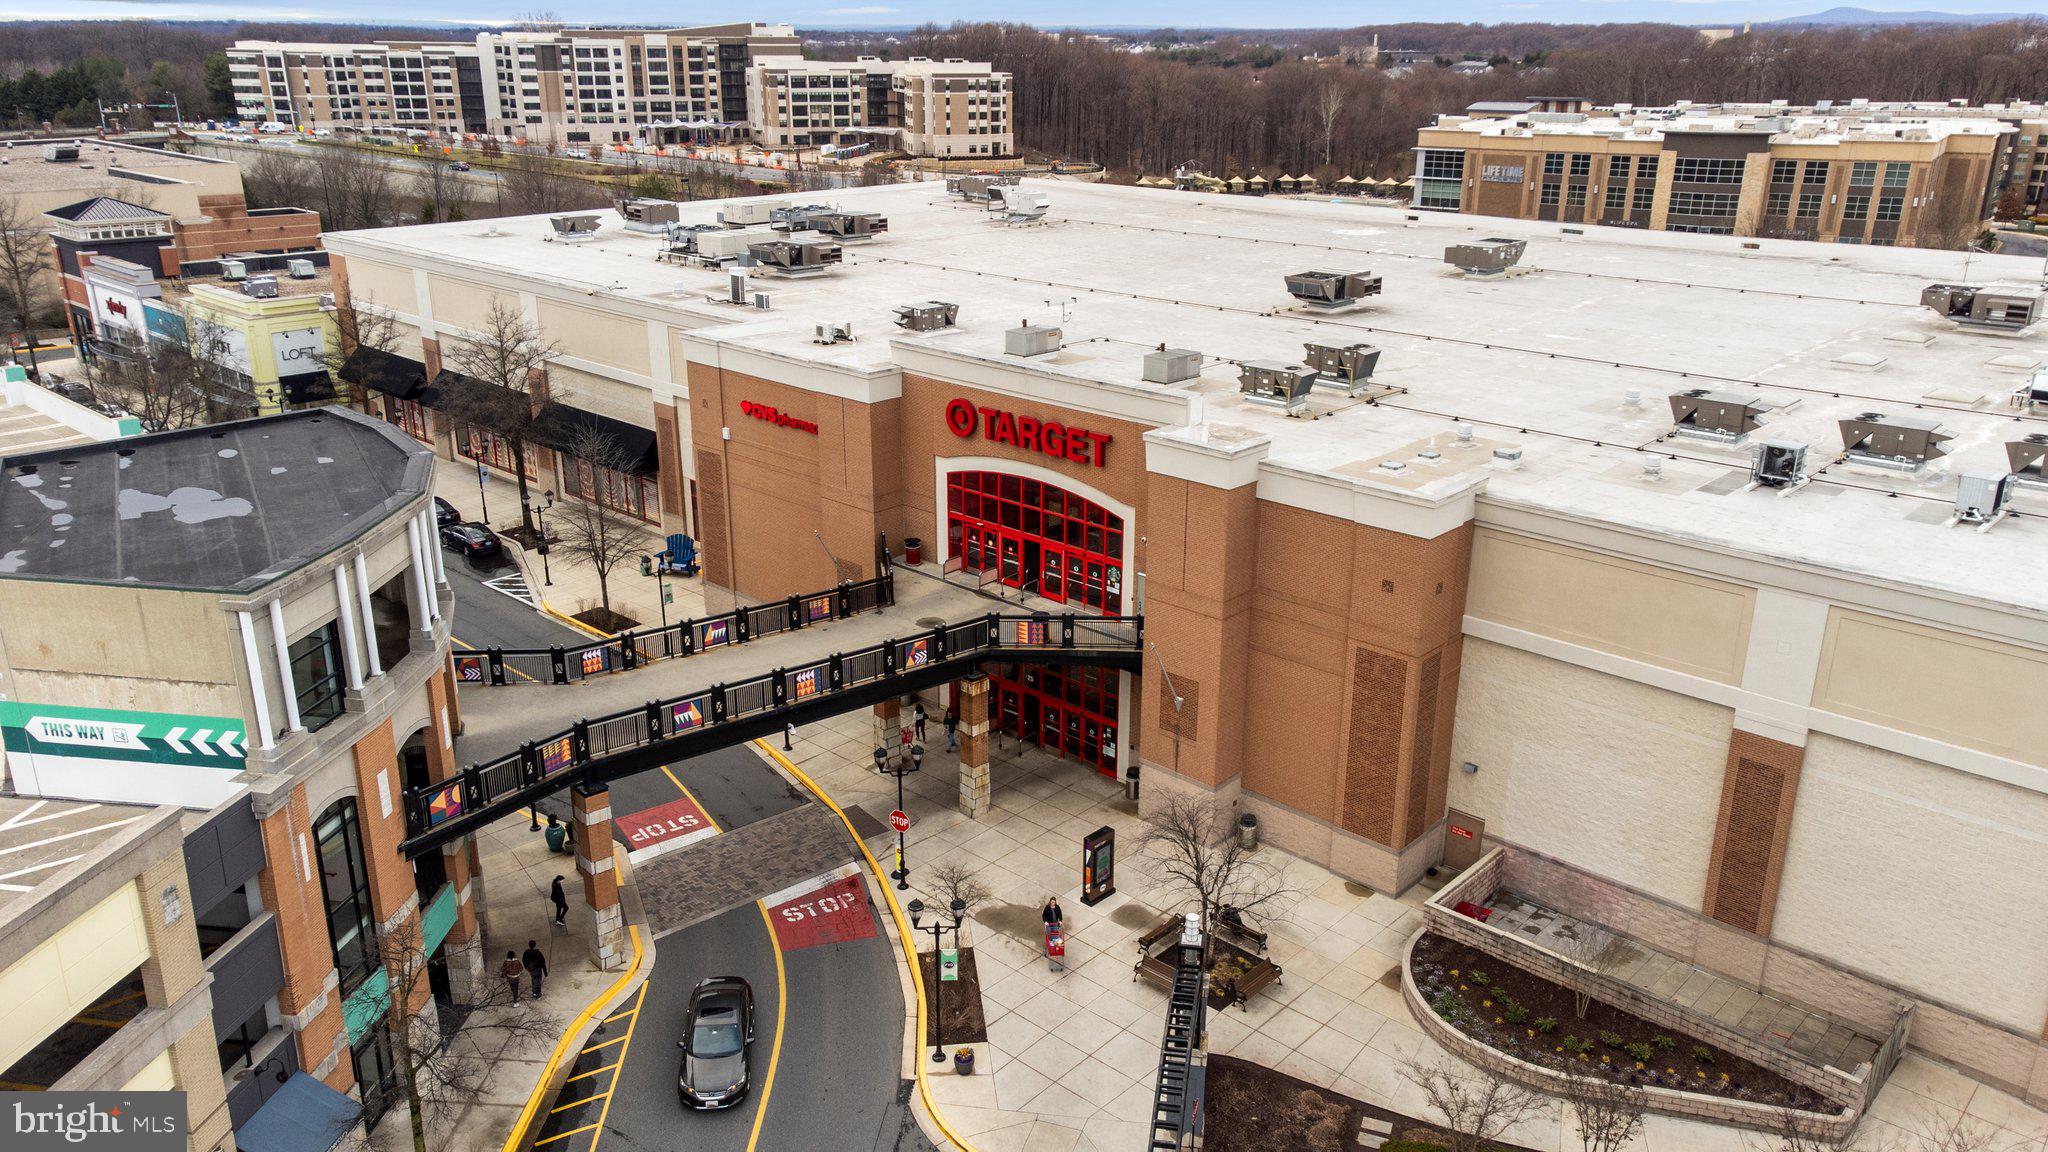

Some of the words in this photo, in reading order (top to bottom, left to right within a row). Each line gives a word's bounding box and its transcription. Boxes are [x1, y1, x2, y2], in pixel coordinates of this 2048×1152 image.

[1482, 164, 1501, 177] LIFE
[1502, 166, 1524, 179] TIME
[281, 345, 316, 361] LOFT
[751, 403, 778, 424] CVS
[777, 413, 819, 436] pharmac
[978, 406, 1114, 468] TARGET
[41, 722, 73, 738] THIS
[76, 723, 105, 741] WAY
[631, 814, 699, 842] STOP
[891, 815, 909, 827] STOP
[782, 892, 855, 922] STOP
